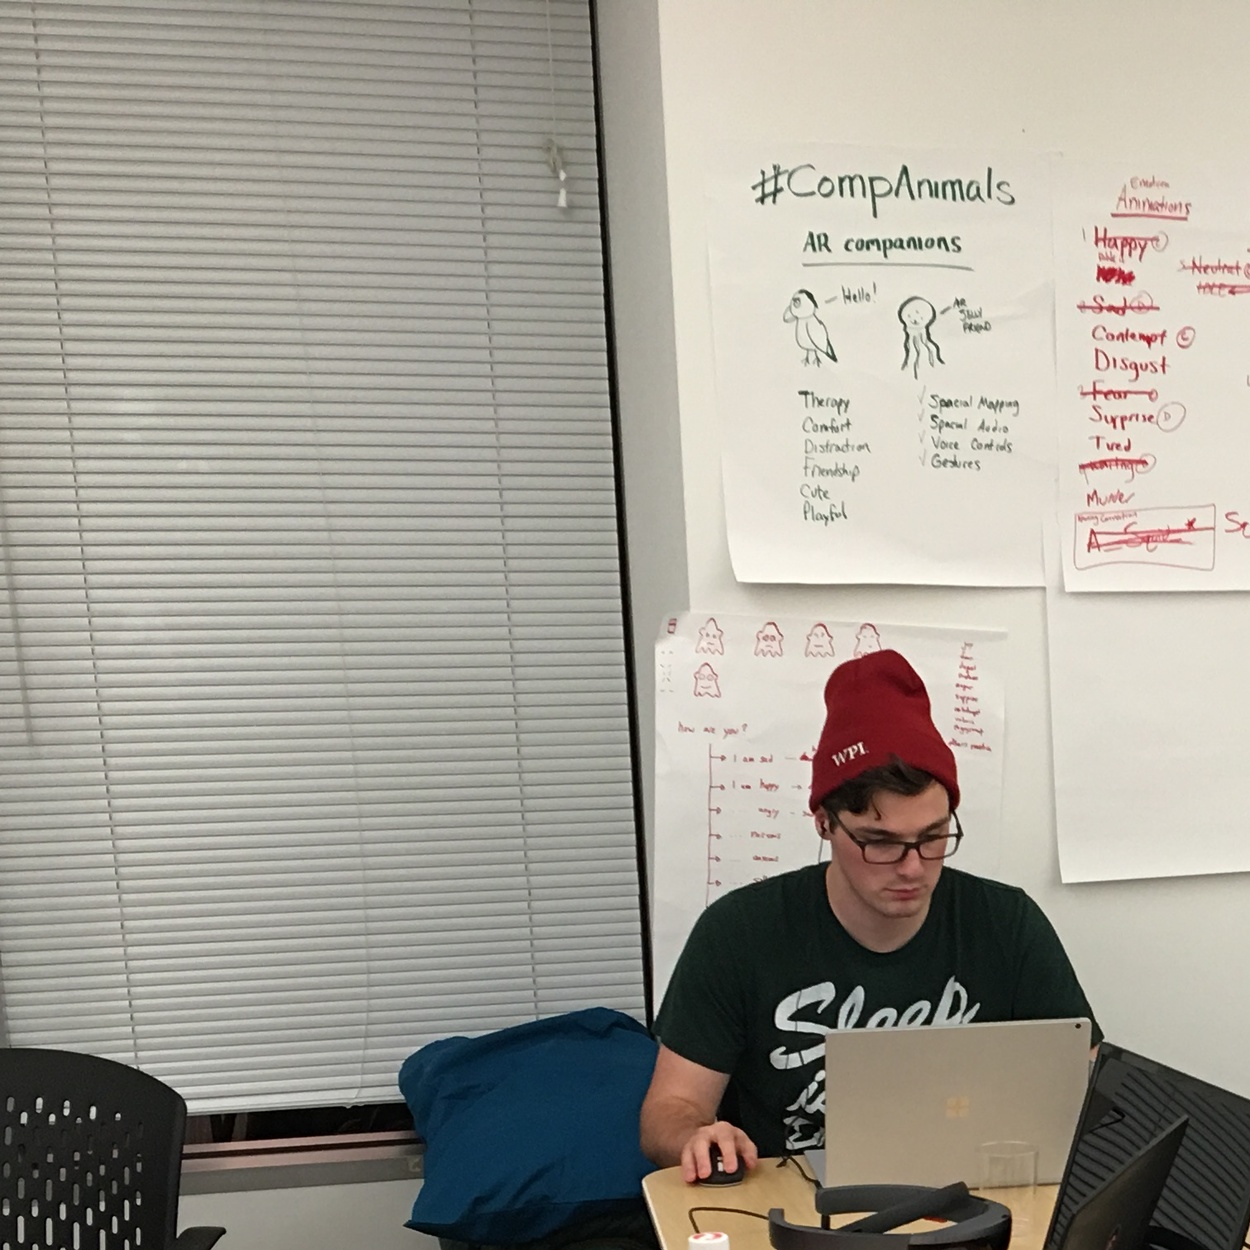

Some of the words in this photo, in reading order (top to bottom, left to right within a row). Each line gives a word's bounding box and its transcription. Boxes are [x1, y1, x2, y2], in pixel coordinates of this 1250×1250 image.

[751, 163, 1015, 219] #CompAnimals
[802, 231, 832, 253] AR
[844, 235, 962, 259] companions
[841, 281, 877, 305] Hello!
[1092, 324, 1167, 349] Contempt
[1094, 347, 1170, 382] Disgust
[798, 390, 850, 416] Therapy
[977, 396, 1019, 417] Mapping
[801, 416, 852, 434] Comfort
[977, 418, 1009, 434] Audio
[1088, 404, 1157, 430] Surprise
[804, 437, 871, 454] Distraction
[931, 436, 960, 450] Voice
[971, 437, 1013, 453] Controls
[802, 455, 861, 482] Friendship
[931, 453, 981, 471] Gestures
[800, 483, 831, 501] Cute
[803, 500, 848, 527] Playful
[831, 742, 866, 767] WPI
